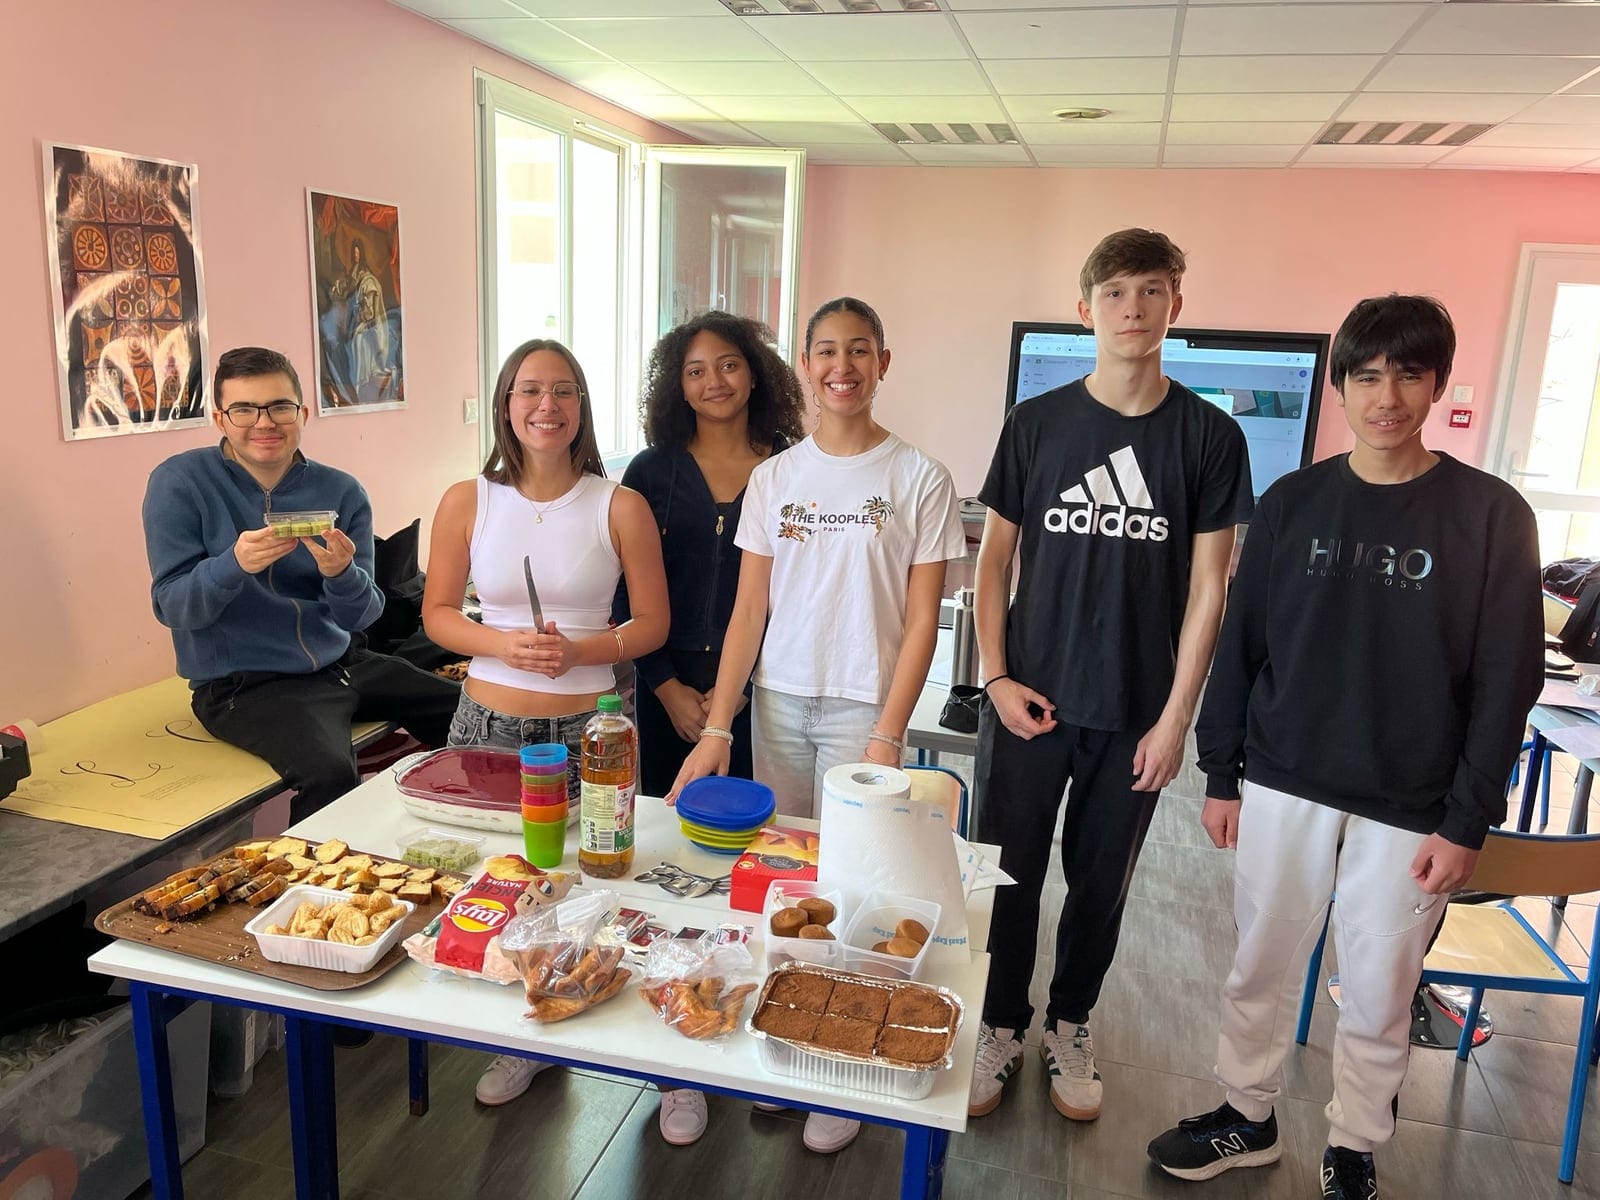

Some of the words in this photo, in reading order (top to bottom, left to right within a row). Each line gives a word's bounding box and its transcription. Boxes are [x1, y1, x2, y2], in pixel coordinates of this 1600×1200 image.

[792, 513, 815, 523] THE
[819, 514, 878, 525] KOOPLES
[1044, 502, 1169, 542] adidas
[1308, 538, 1433, 580] HUGO
[486, 878, 522, 889] NATURE
[453, 902, 506, 927] Lay's
